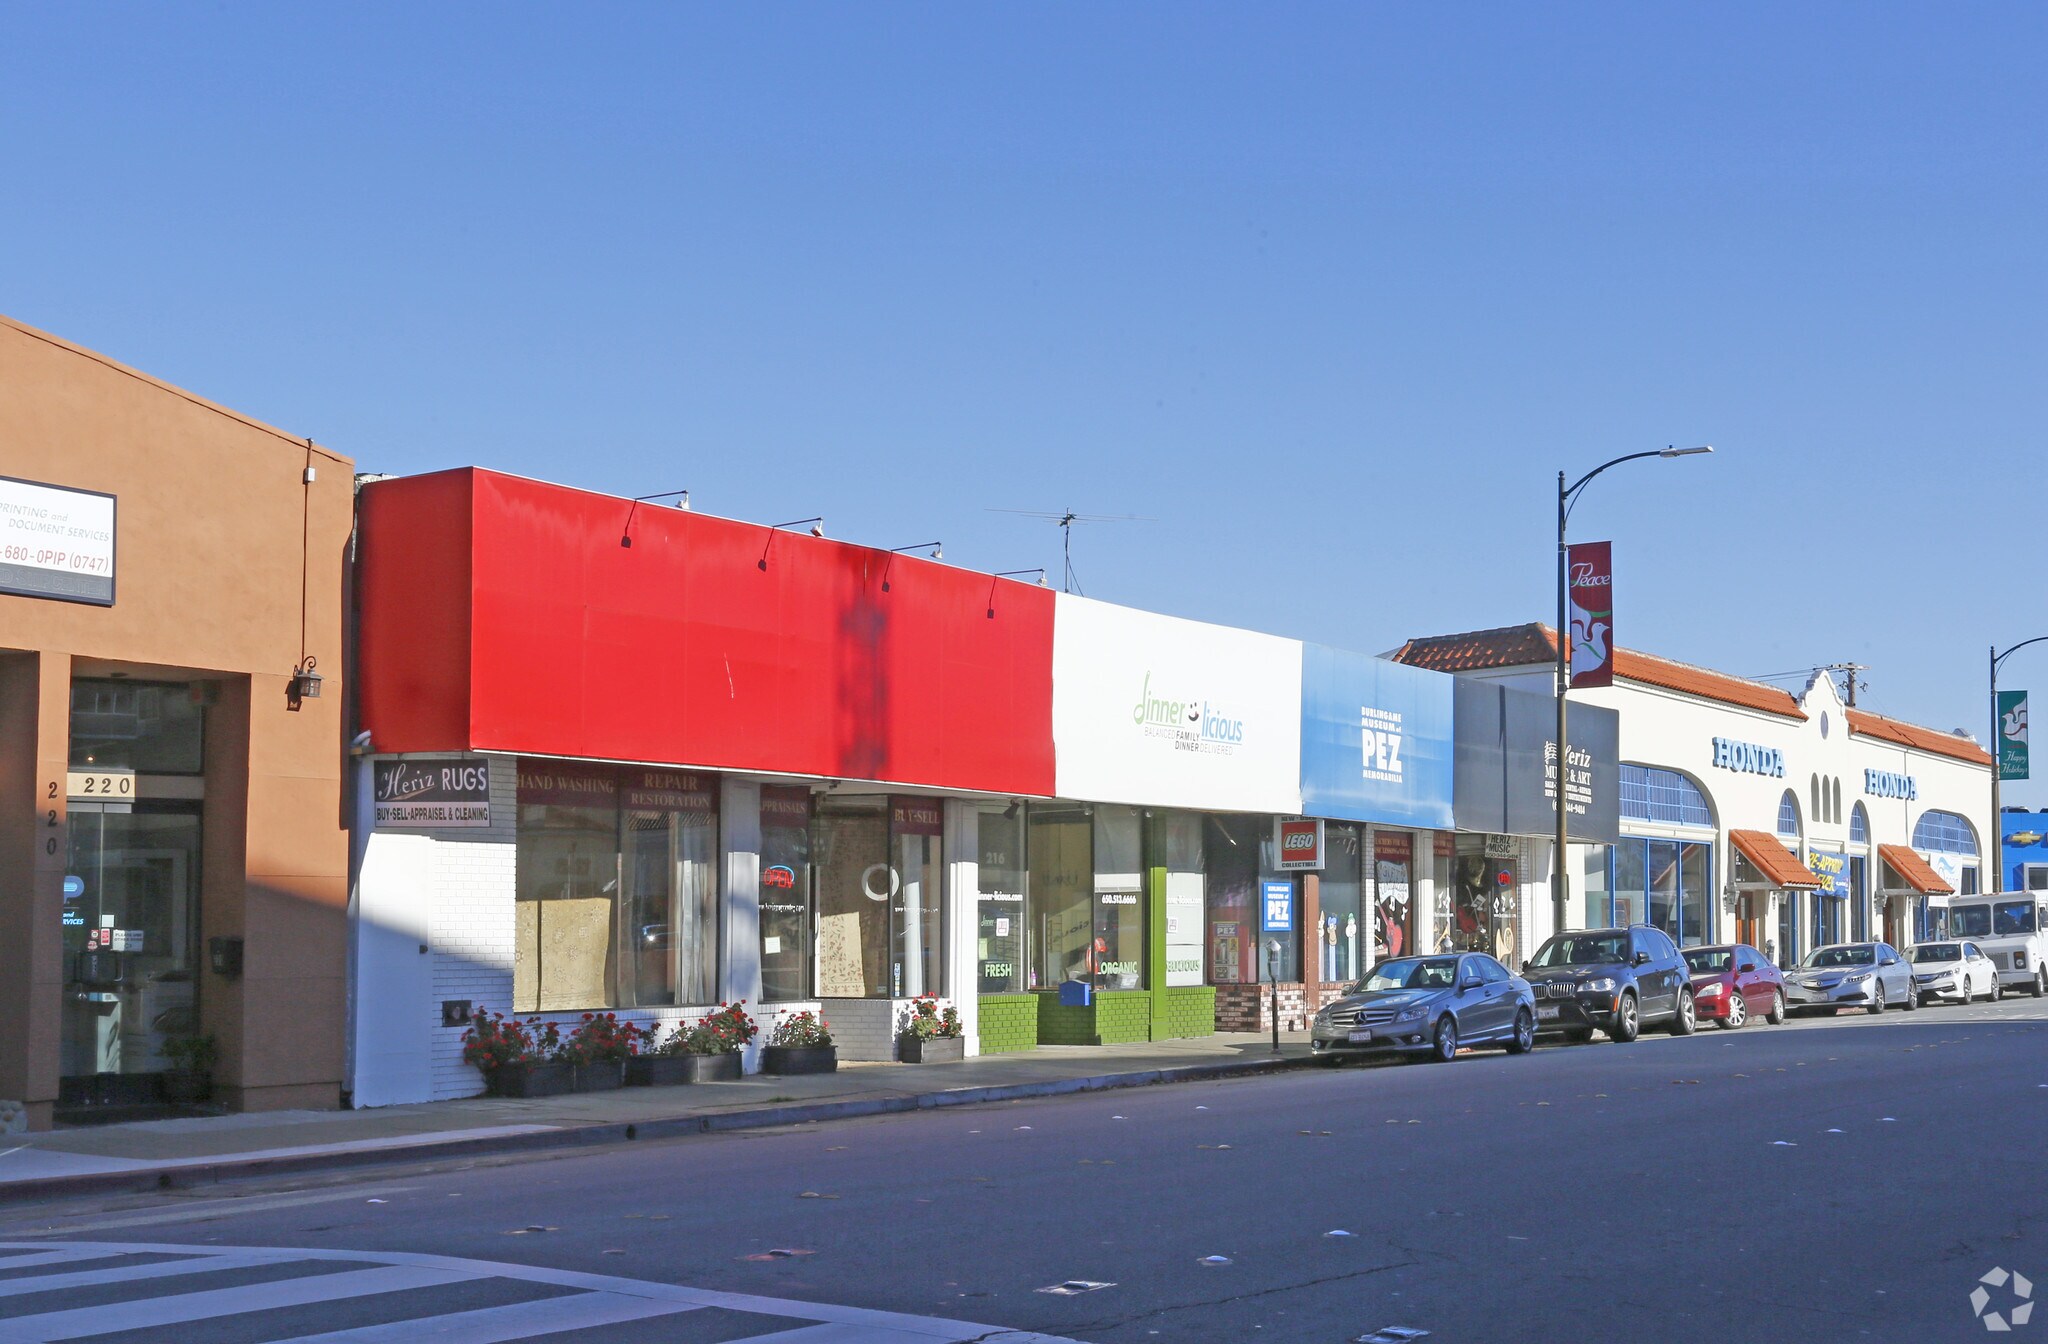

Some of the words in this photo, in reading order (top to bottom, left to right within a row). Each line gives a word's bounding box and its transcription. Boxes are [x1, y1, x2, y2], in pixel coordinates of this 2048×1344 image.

[51, 513, 68, 522] and
[8, 518, 65, 535] DOCUMENT
[67, 527, 109, 541] SERVICES
[69, 551, 109, 573] (0747)
[1570, 562, 1610, 588] Peace
[1133, 670, 1186, 725] dinner
[1201, 701, 1243, 742] licious
[1361, 706, 1402, 723] BURLINGAME
[1361, 717, 1396, 732] MUSEUM
[1176, 730, 1200, 742] FAMILY
[1174, 740, 1200, 752] DINNER
[1362, 728, 1402, 773] PEZ
[1712, 737, 1787, 778] HONDA
[2007, 751, 2027, 764] Happy
[378, 763, 435, 800] Heriz
[442, 767, 487, 791] RUGS
[516, 773, 552, 790] HAND
[557, 776, 614, 793] WASHING
[644, 773, 698, 790] REPAIR
[1362, 769, 1403, 784] MEMORABILIA
[1577, 770, 1592, 786] ART
[1864, 768, 1919, 801] HONDA
[84, 777, 130, 794] 220
[631, 792, 710, 808] RESTORATION
[760, 800, 806, 815] PPRAISALS
[448, 808, 453, 820] &
[455, 807, 488, 821] CLEANING
[1284, 833, 1315, 850] LEGO
[1490, 834, 1511, 845] HERIZ
[1489, 843, 1511, 853] MUSIC
[986, 852, 1005, 864] 216
[1281, 860, 1317, 868] COLLECTIBLE
[763, 869, 793, 888] OPEN
[1101, 894, 1137, 905] 650.513.6666
[1267, 900, 1289, 920] PEZ
[1217, 927, 1236, 935] PEZ
[985, 963, 1012, 977] FRESH
[1101, 961, 1137, 975] ORGANIC
